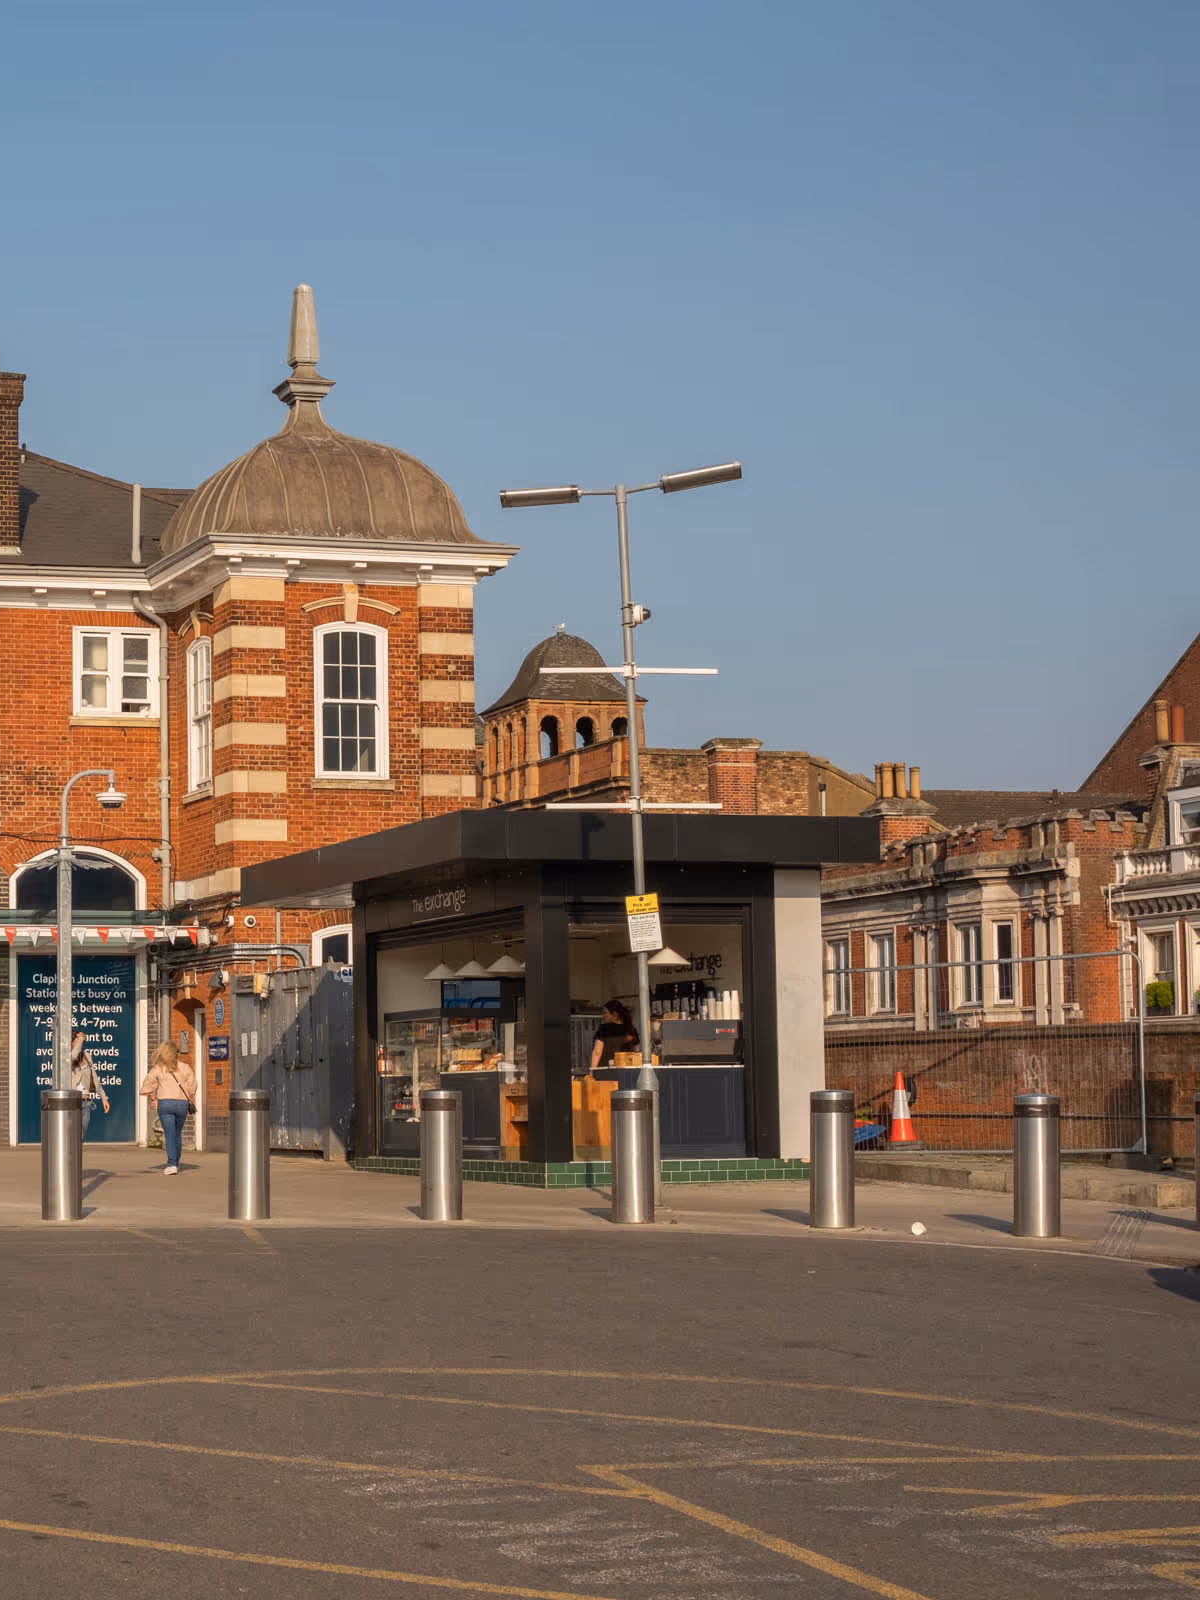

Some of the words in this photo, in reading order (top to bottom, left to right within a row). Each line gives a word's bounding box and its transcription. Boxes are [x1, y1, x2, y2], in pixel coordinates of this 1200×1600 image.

[412, 899, 424, 912] The
[424, 889, 466, 912] exchange
[77, 974, 120, 984] Junction
[88, 988, 111, 1000] busy
[80, 1003, 123, 1012] between
[71, 1017, 78, 1027] &
[45, 1031, 53, 1041] If
[102, 1032, 113, 1042] to
[84, 1046, 120, 1056] crowds
